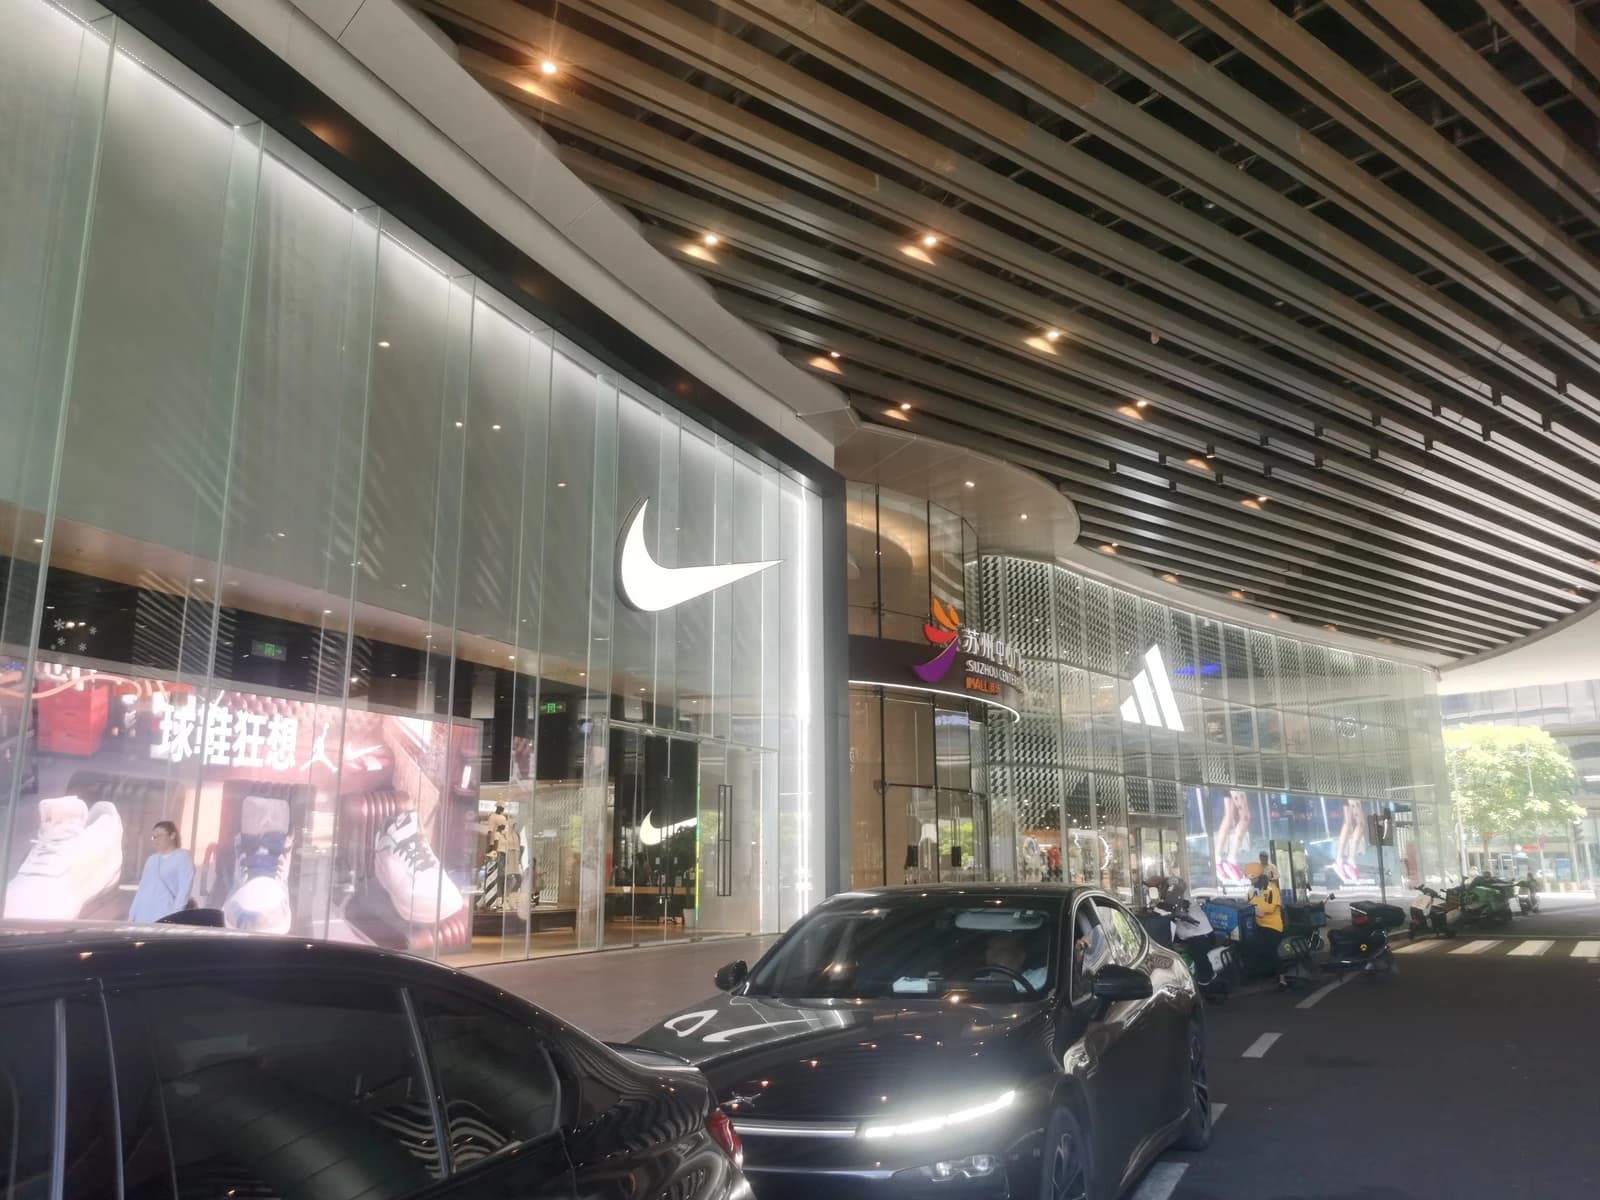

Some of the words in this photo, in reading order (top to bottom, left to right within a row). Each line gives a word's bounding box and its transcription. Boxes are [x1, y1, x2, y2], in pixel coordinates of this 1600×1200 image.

[965, 659, 998, 679] SUZHOU
[158, 703, 299, 770] 球鞋狂想
